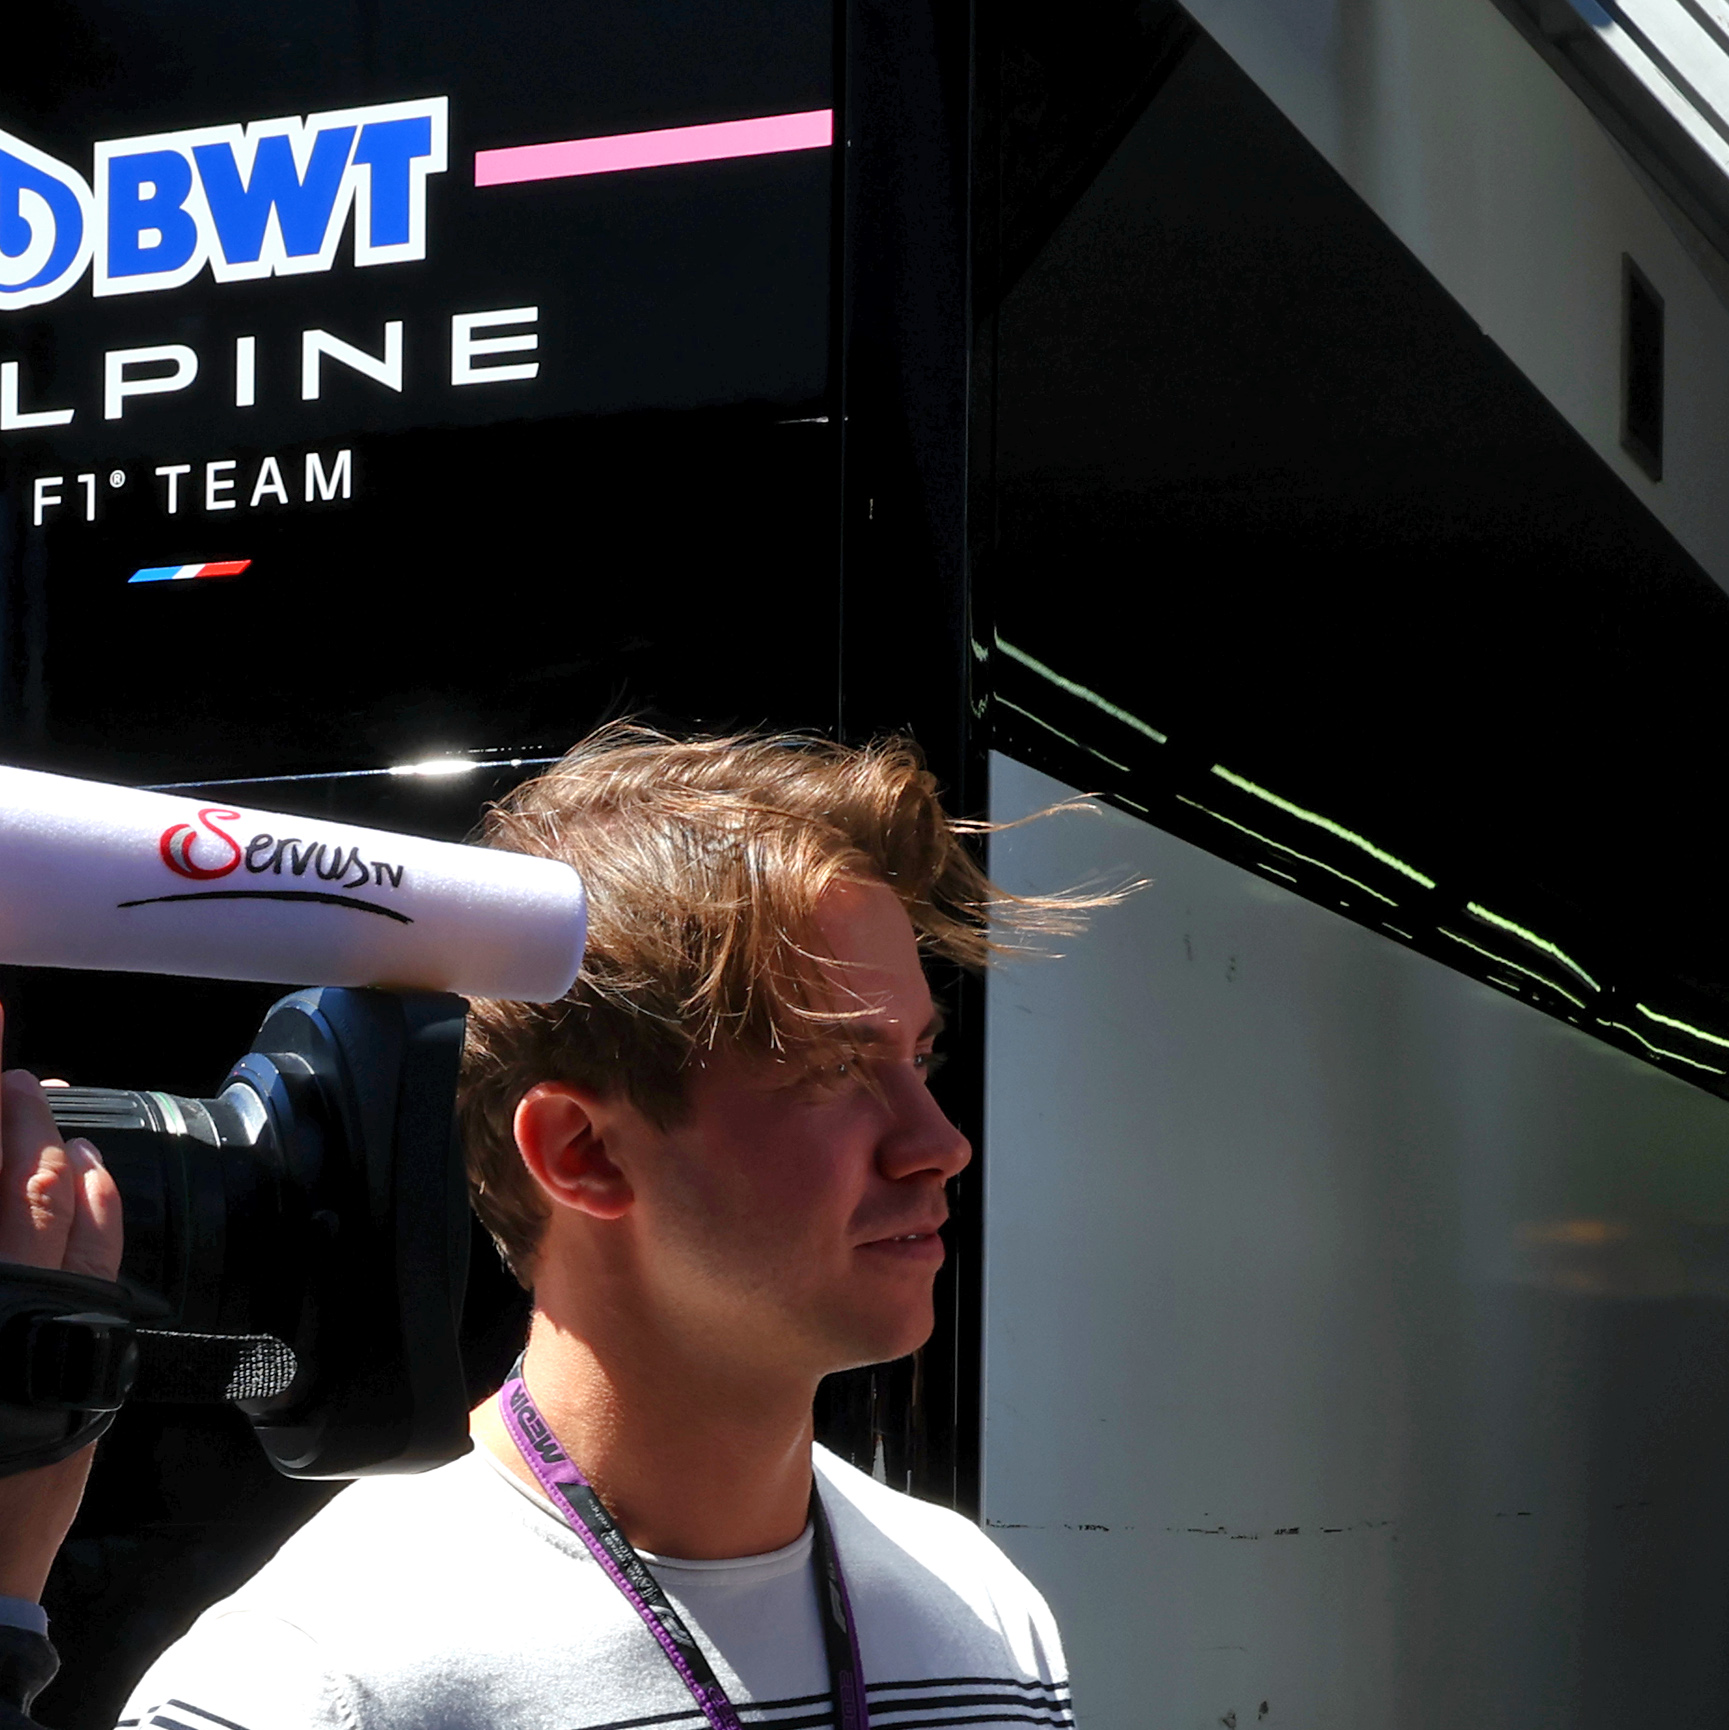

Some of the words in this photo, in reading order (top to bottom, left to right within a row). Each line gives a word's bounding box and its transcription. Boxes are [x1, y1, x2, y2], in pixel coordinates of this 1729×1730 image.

[95, 98, 447, 296] BWT
[157, 448, 353, 512] TEAM
[510, 1384, 567, 1465] MEDIA
